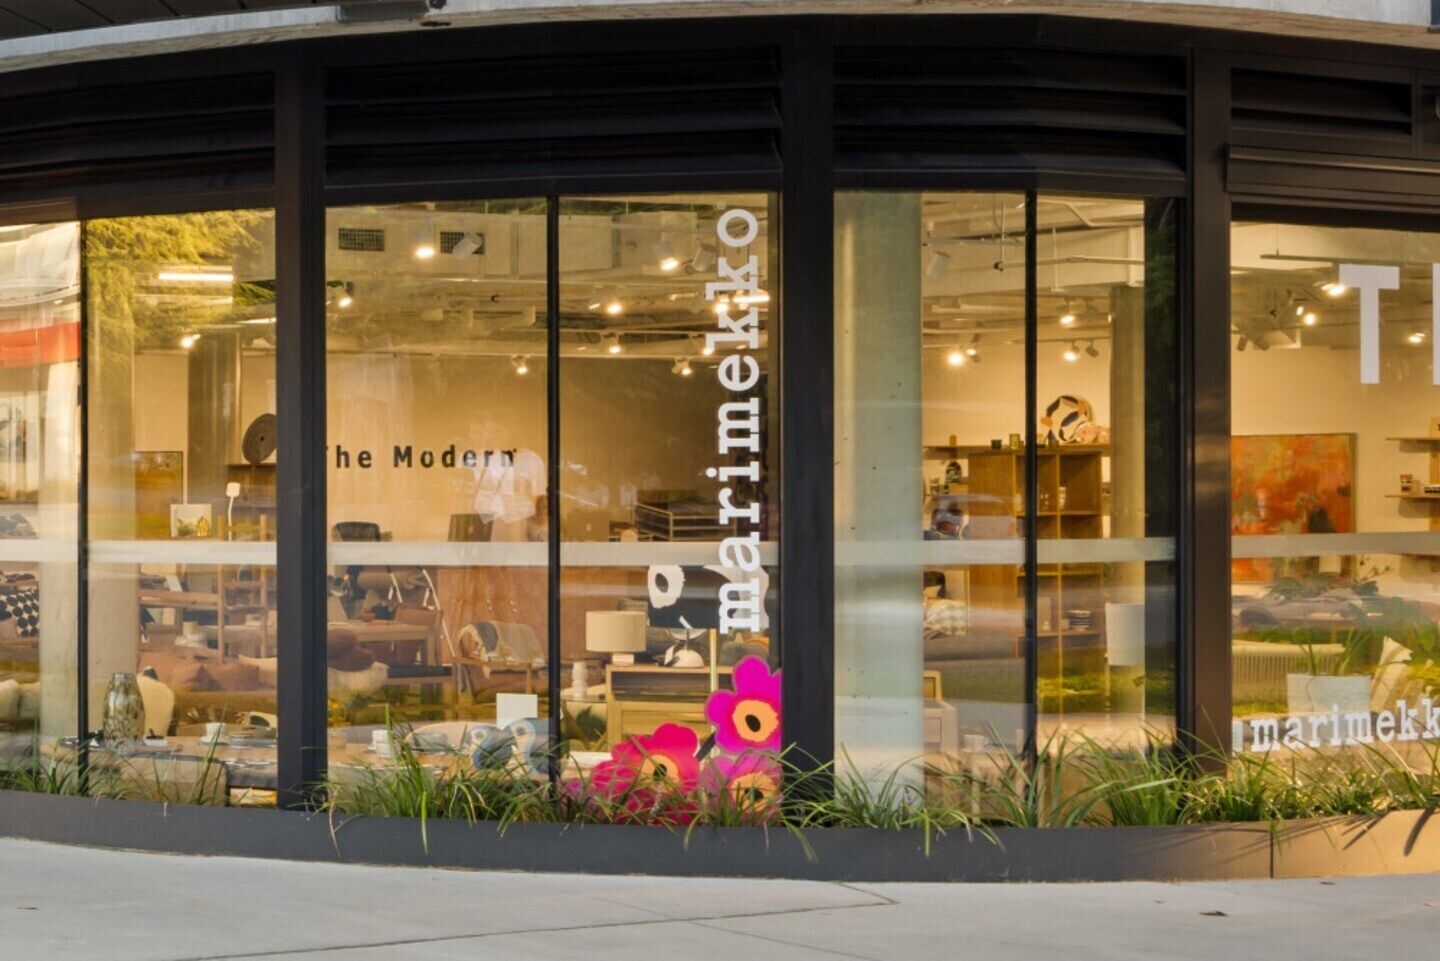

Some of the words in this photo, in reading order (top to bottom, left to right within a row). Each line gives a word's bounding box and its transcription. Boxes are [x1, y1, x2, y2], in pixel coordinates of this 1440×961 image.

[326, 445, 373, 469] he
[393, 445, 517, 469] Modern
[705, 208, 760, 635] marimekko
